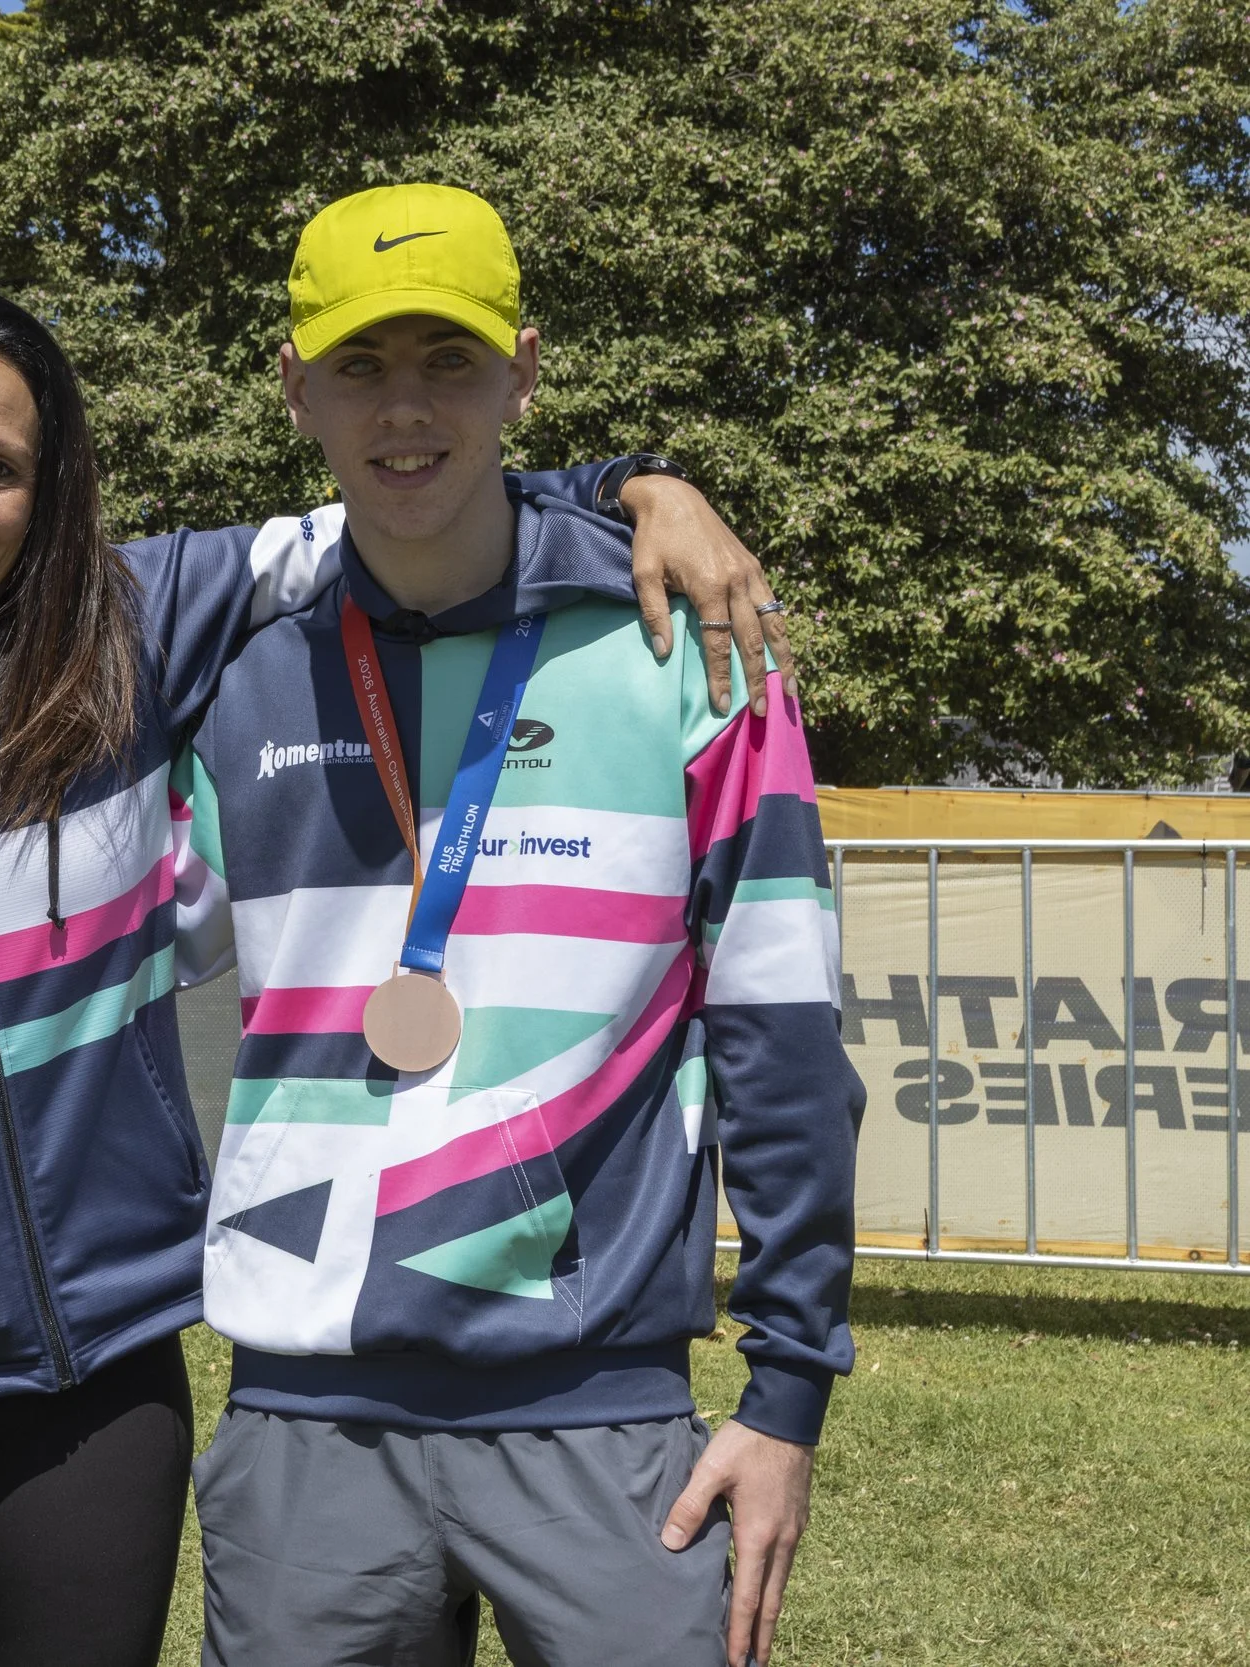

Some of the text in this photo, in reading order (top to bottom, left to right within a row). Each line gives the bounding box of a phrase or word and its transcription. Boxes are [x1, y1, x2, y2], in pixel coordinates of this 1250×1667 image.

[357, 654, 375, 690] 2026
[367, 693, 392, 759] Australian
[438, 845, 455, 873] AUS
[449, 804, 481, 874] TRIATHLON
